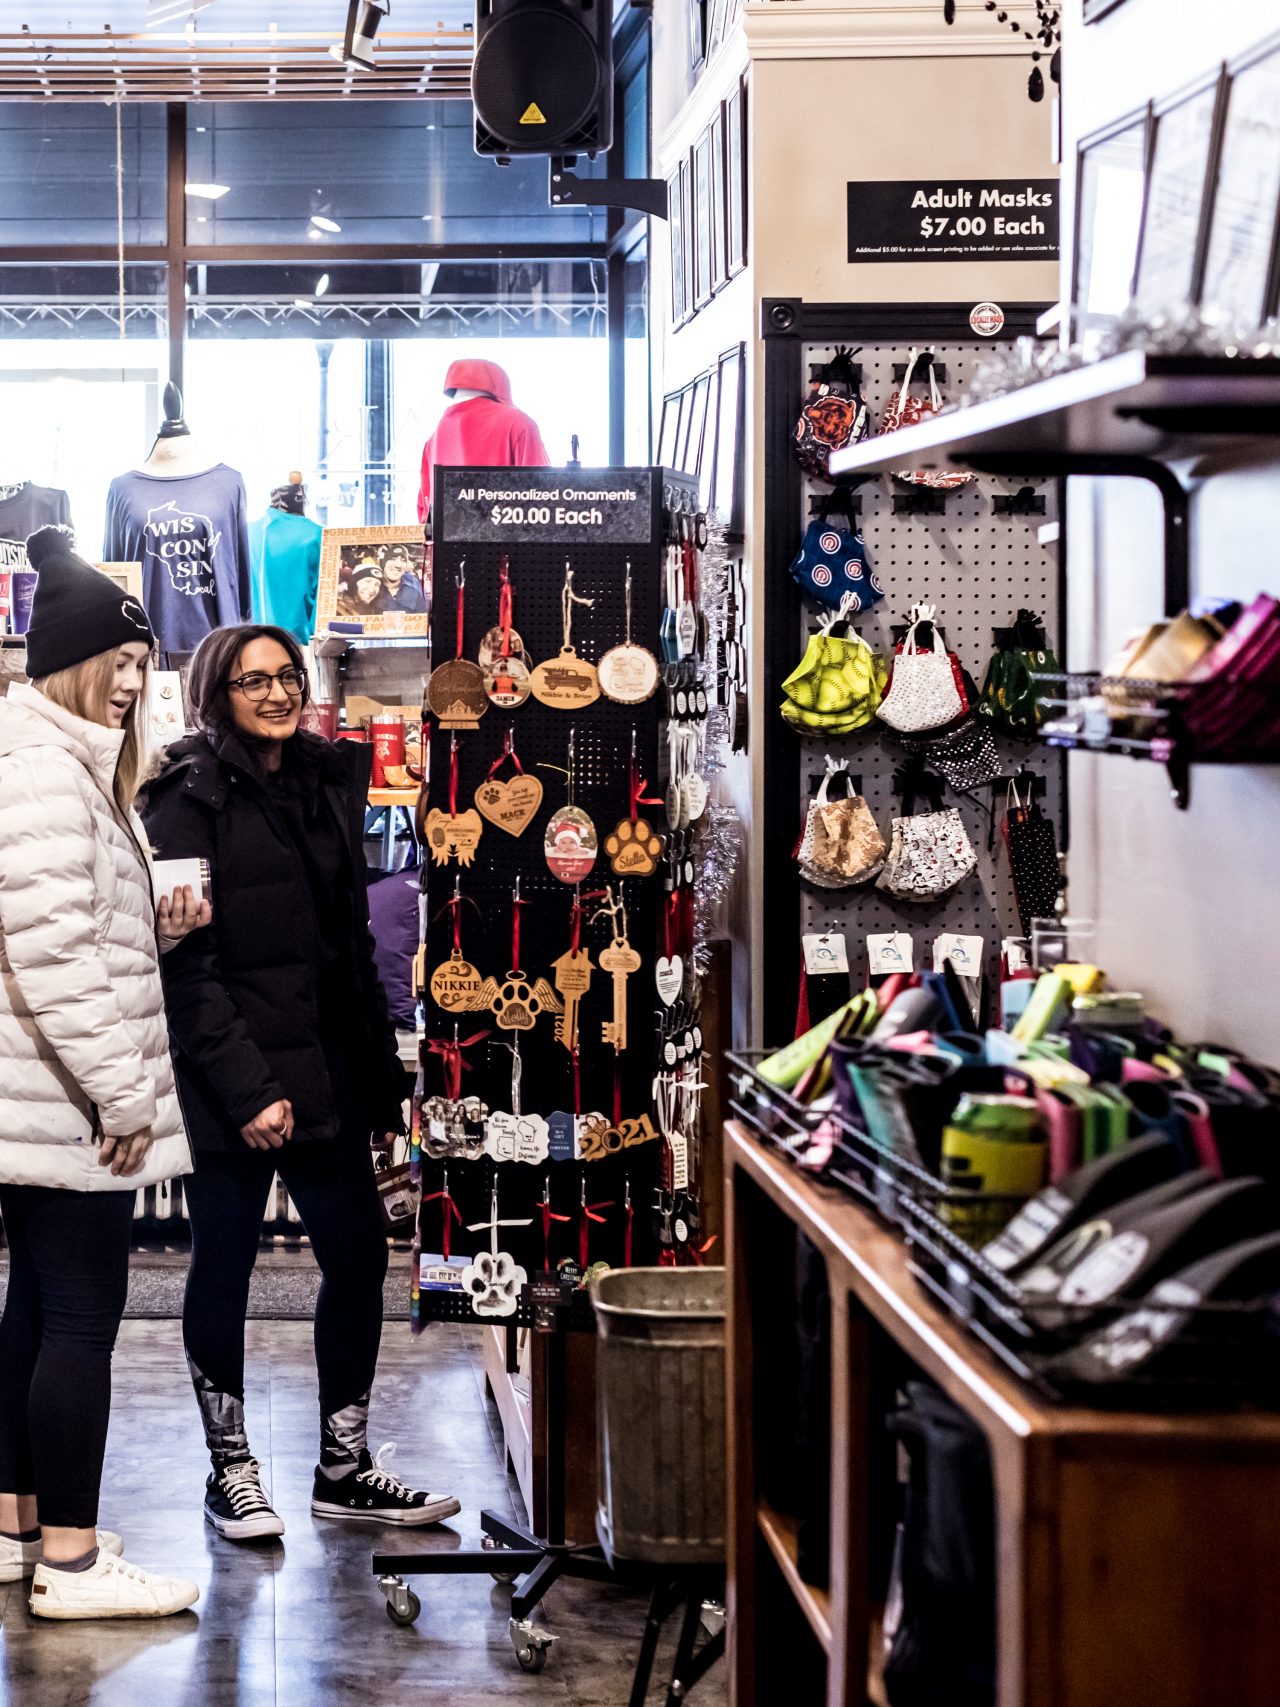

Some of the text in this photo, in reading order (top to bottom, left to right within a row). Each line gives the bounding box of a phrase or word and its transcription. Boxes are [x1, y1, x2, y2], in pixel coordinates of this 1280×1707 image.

[911, 187, 1053, 208] Adult Masks
[920, 215, 1045, 238] $7.00 Each
[458, 488, 636, 500] All Personalized Ornaments
[491, 506, 602, 525] $20.00 Each
[148, 517, 195, 537] WIS
[329, 527, 366, 537] GREEN
[370, 527, 391, 536] BAY
[161, 538, 207, 557] CON
[177, 560, 212, 577] SIN
[185, 579, 216, 596] Local
[500, 809, 526, 820] MACK
[620, 852, 645, 869] Stella
[434, 981, 479, 991] NIKKIE
[554, 1015, 565, 1042] 2021
[578, 1113, 660, 1162] 2021
